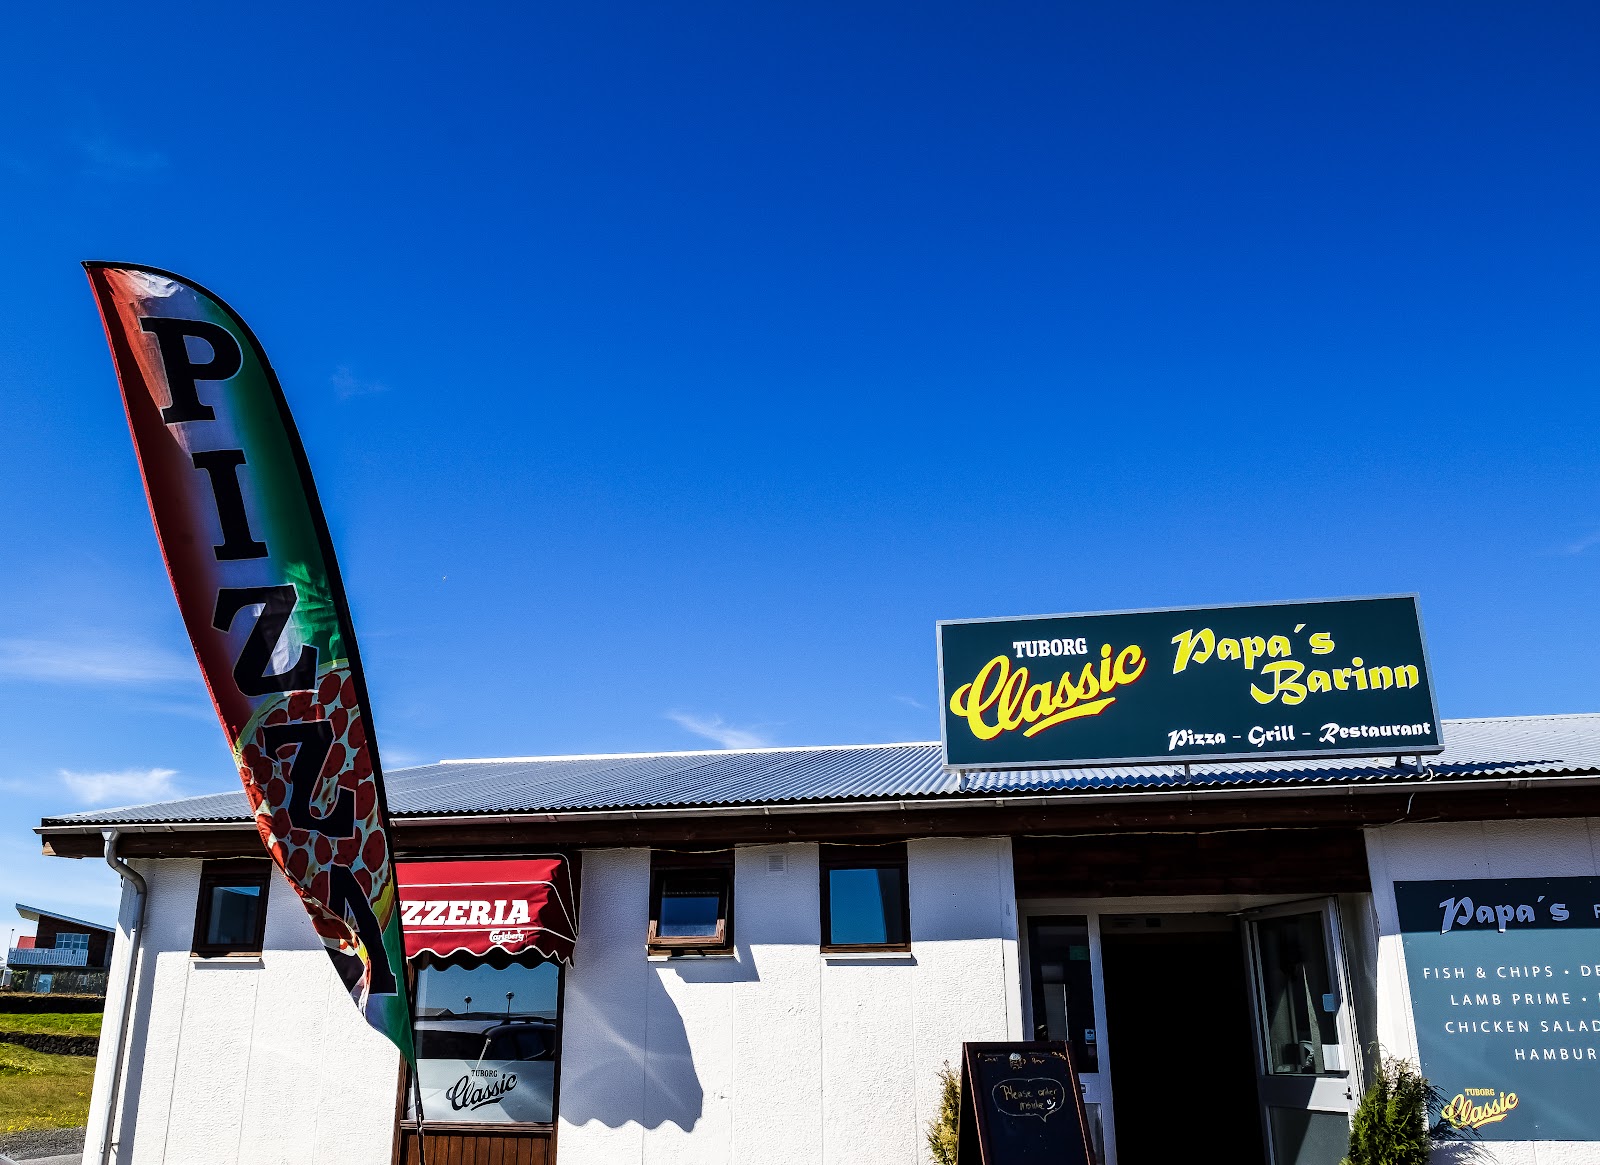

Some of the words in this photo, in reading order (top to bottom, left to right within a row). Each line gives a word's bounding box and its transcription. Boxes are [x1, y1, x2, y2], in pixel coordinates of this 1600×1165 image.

[140, 316, 398, 998] PIZZA
[1013, 638, 1088, 659] TUBORG
[1250, 657, 1420, 706] Barinn
[949, 643, 1148, 740] Classic
[1168, 729, 1226, 751] Pizza
[1248, 725, 1295, 748] Grill
[1319, 720, 1431, 745] Restaurant
[400, 899, 530, 926] ZZERIA
[489, 929, 525, 945] Carlsberg
[1423, 967, 1465, 979] FISH
[1476, 967, 1487, 979] &
[1496, 965, 1553, 978] CHIPS
[1450, 993, 1501, 1006] LAMB
[1512, 992, 1571, 1005] PRIME
[1445, 1020, 1530, 1034] CHICKEN
[1514, 1048, 1597, 1061] HAMBUR
[470, 1069, 498, 1078] TUBORG
[445, 1073, 518, 1112] Classic
[999, 1084, 1034, 1101] Please
[1037, 1086, 1058, 1097] order
[1464, 1088, 1496, 1097] TUBORG
[1441, 1092, 1519, 1129] Classic
